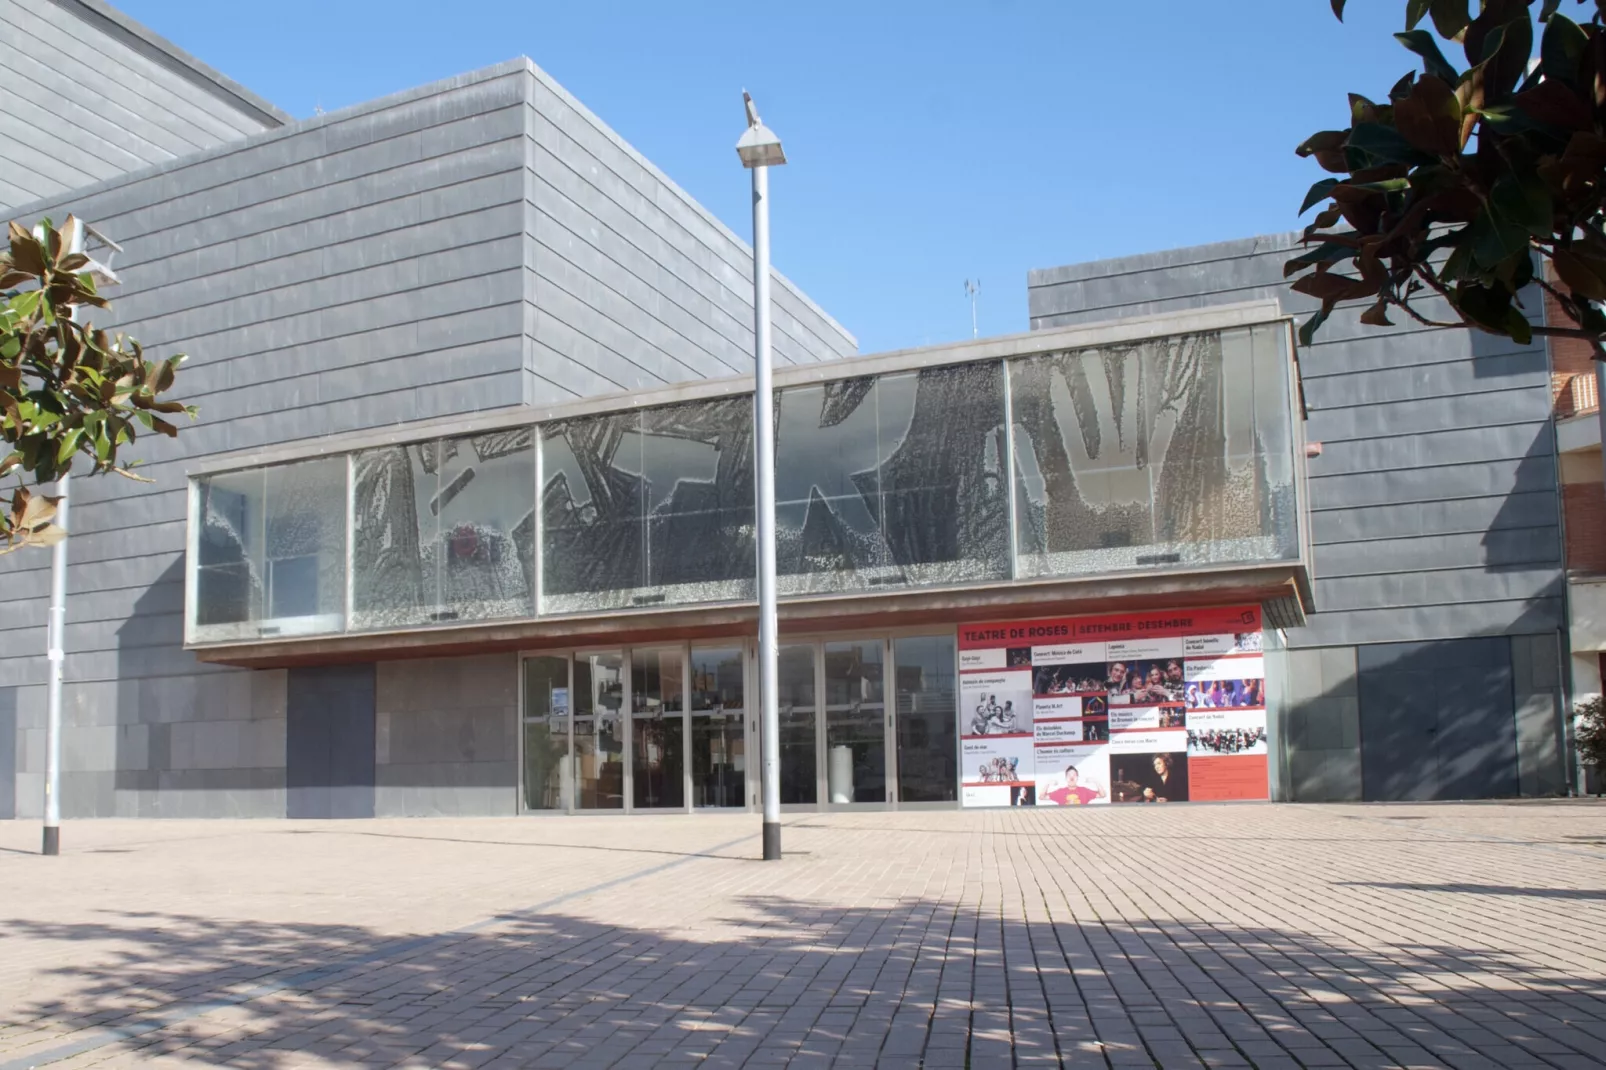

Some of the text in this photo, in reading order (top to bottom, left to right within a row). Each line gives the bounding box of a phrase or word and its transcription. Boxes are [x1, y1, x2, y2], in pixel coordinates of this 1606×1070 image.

[964, 625, 1069, 641] TEATRE DE ROSES
[1079, 622, 1132, 634] SETEMBRE
[1138, 618, 1193, 630] DESEMBRE
